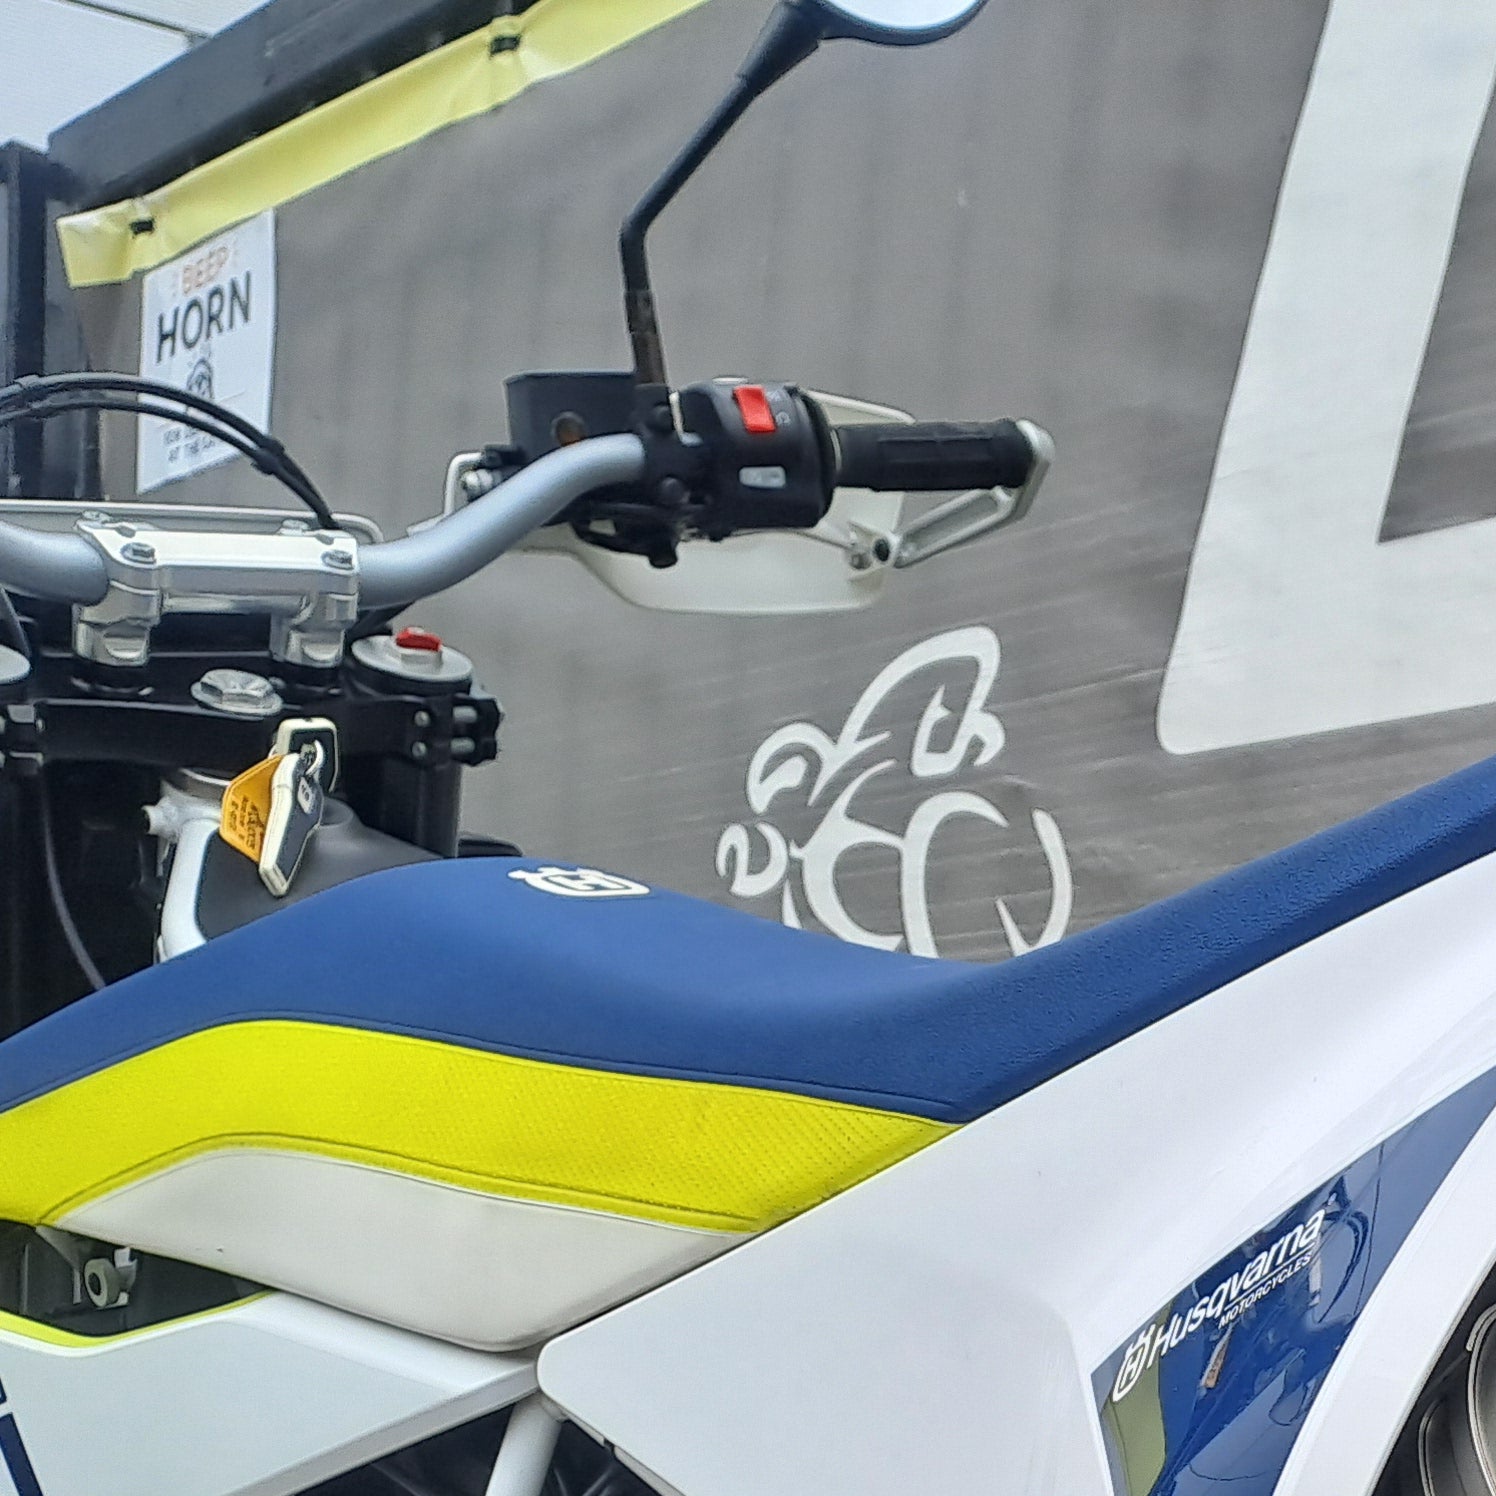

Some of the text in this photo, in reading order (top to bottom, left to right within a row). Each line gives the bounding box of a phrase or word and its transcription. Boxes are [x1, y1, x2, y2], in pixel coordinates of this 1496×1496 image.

[156, 270, 252, 364] HORN
[1148, 1208, 1325, 1367] Husqvarna
[1218, 1254, 1312, 1329] MOTORCYCLES
